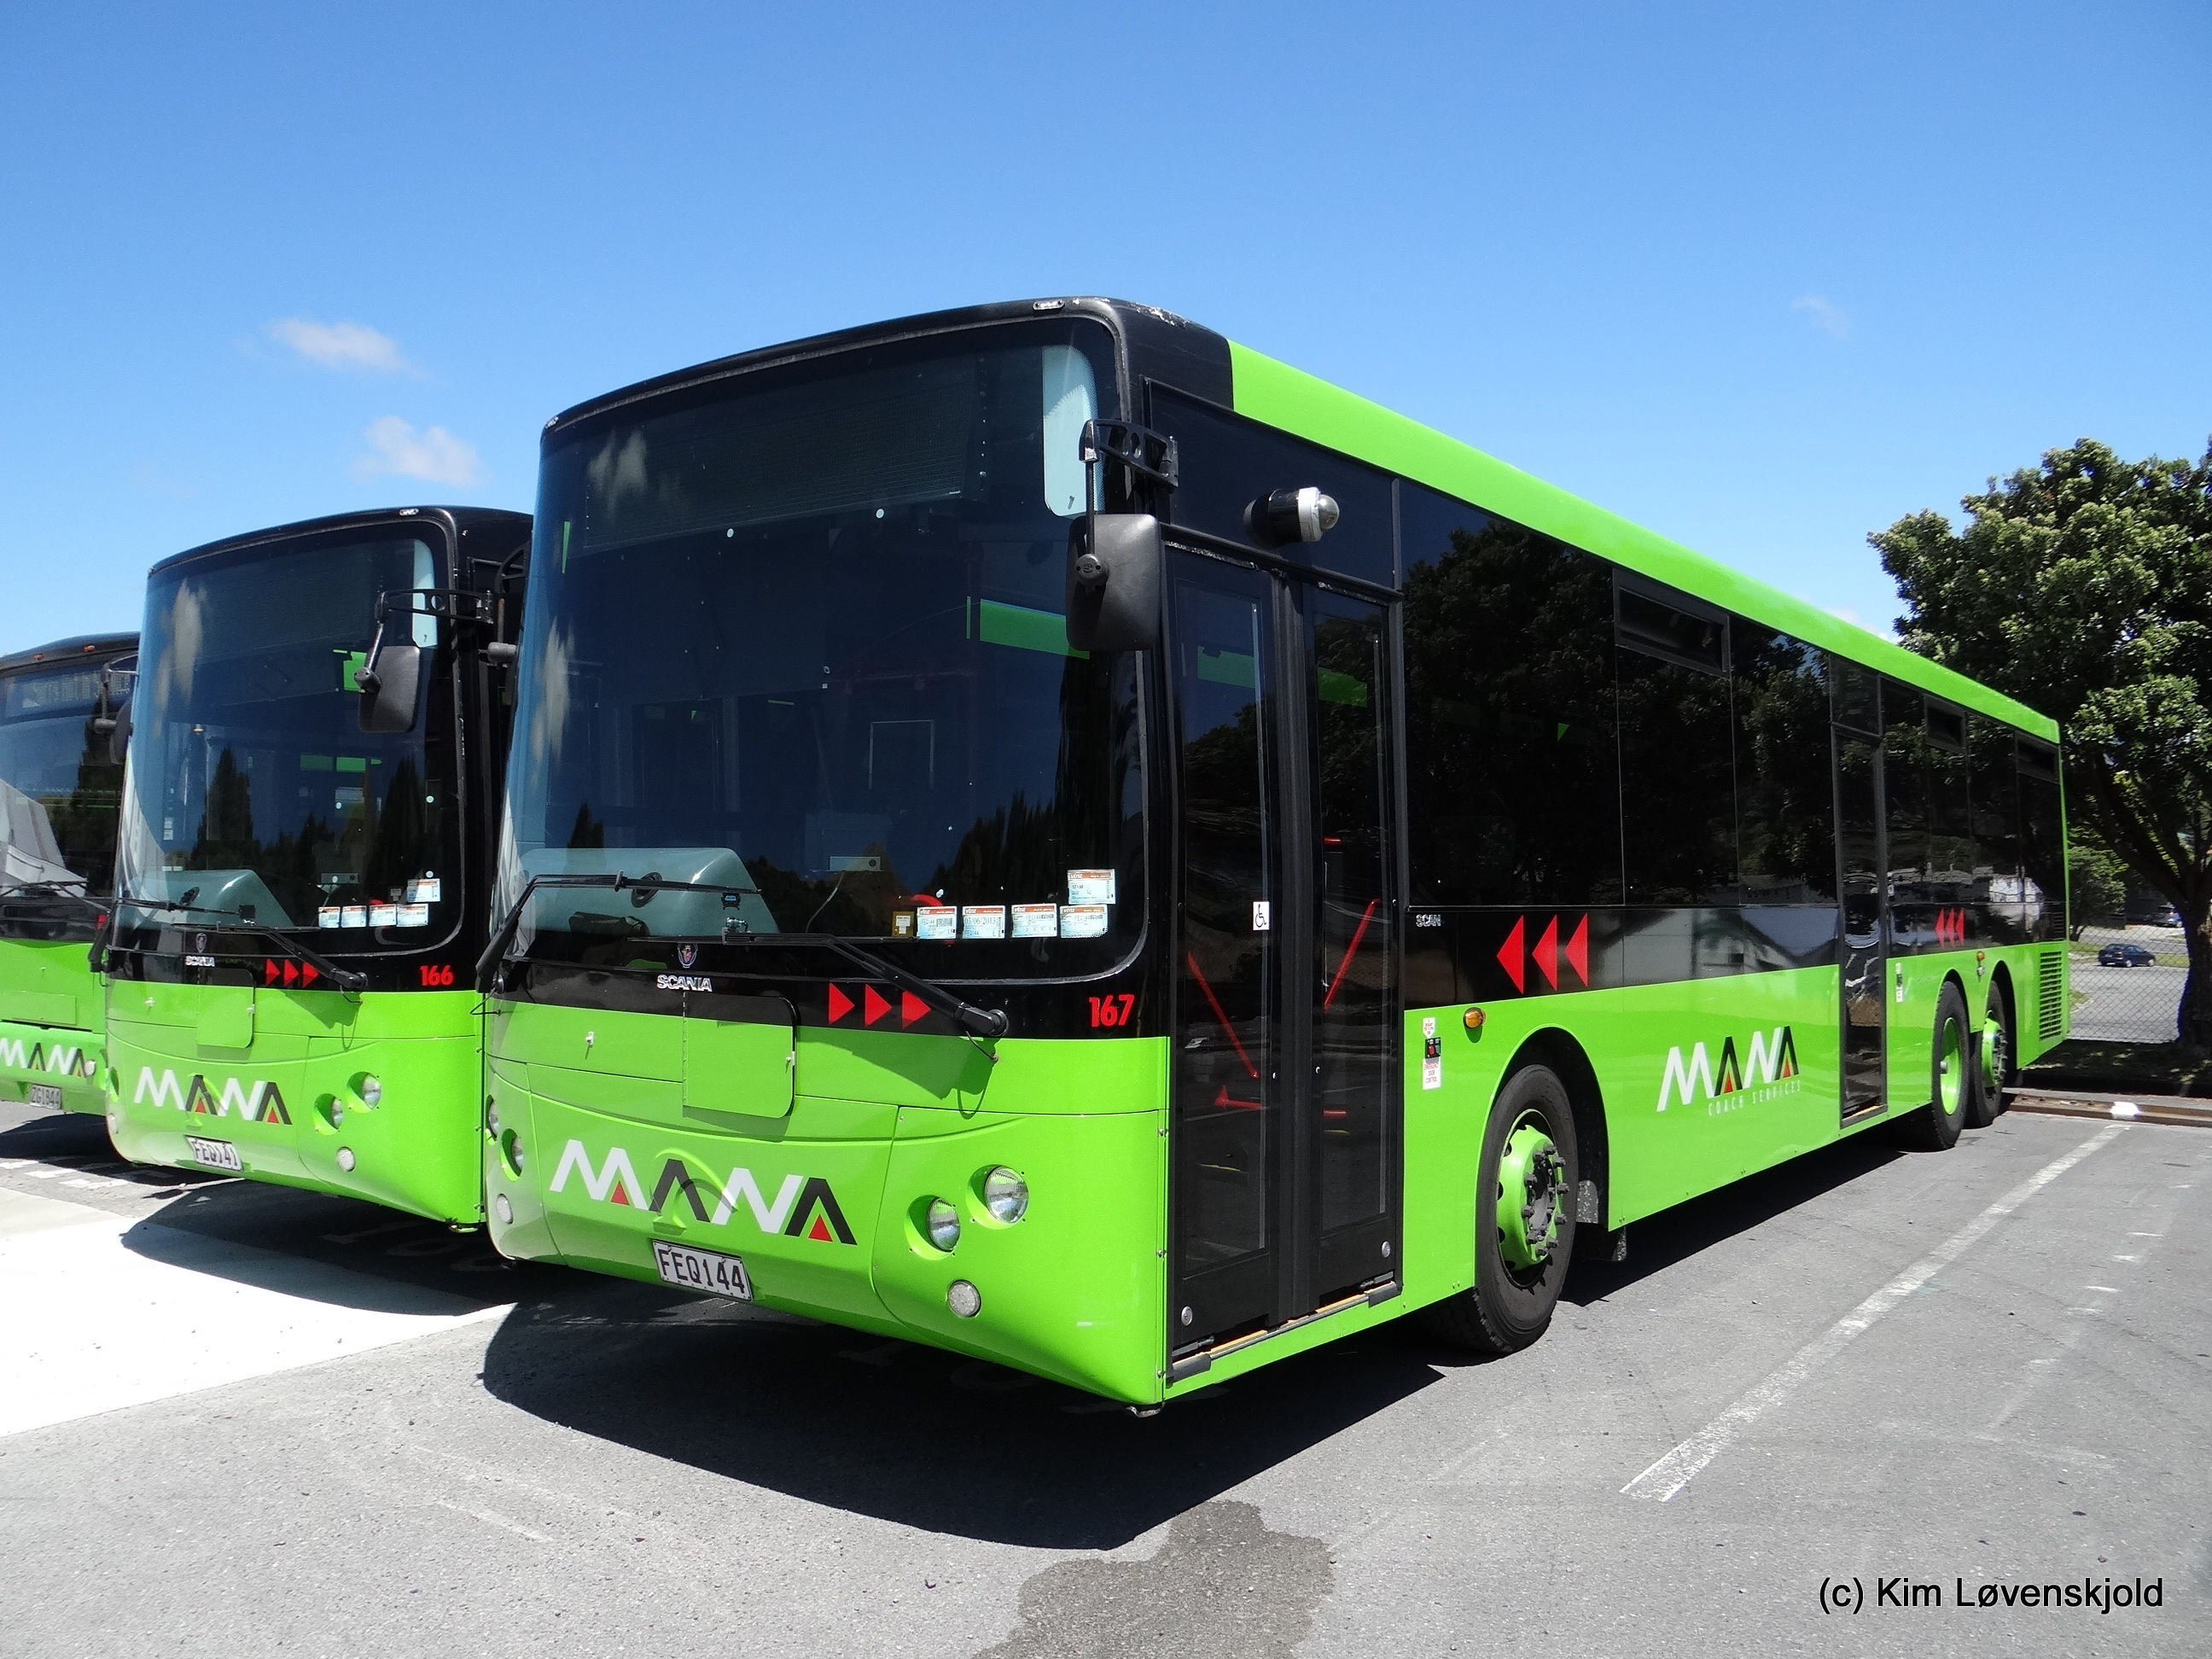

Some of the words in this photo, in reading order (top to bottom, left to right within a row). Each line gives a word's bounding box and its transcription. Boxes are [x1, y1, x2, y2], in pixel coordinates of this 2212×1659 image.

[420, 965, 453, 986] 166
[656, 974, 713, 992] SCANIA
[1088, 994, 1135, 1027] 167
[0, 1037, 87, 1079] MANA
[1656, 1026, 1800, 1112] MANA
[133, 1067, 293, 1126] MANA
[1708, 1095, 1743, 1116] COACH
[1752, 1080, 1801, 1104] SERVICES
[192, 1141, 238, 1167] FEQ141
[549, 1138, 858, 1246] MANA
[657, 1248, 745, 1294] FEQ144
